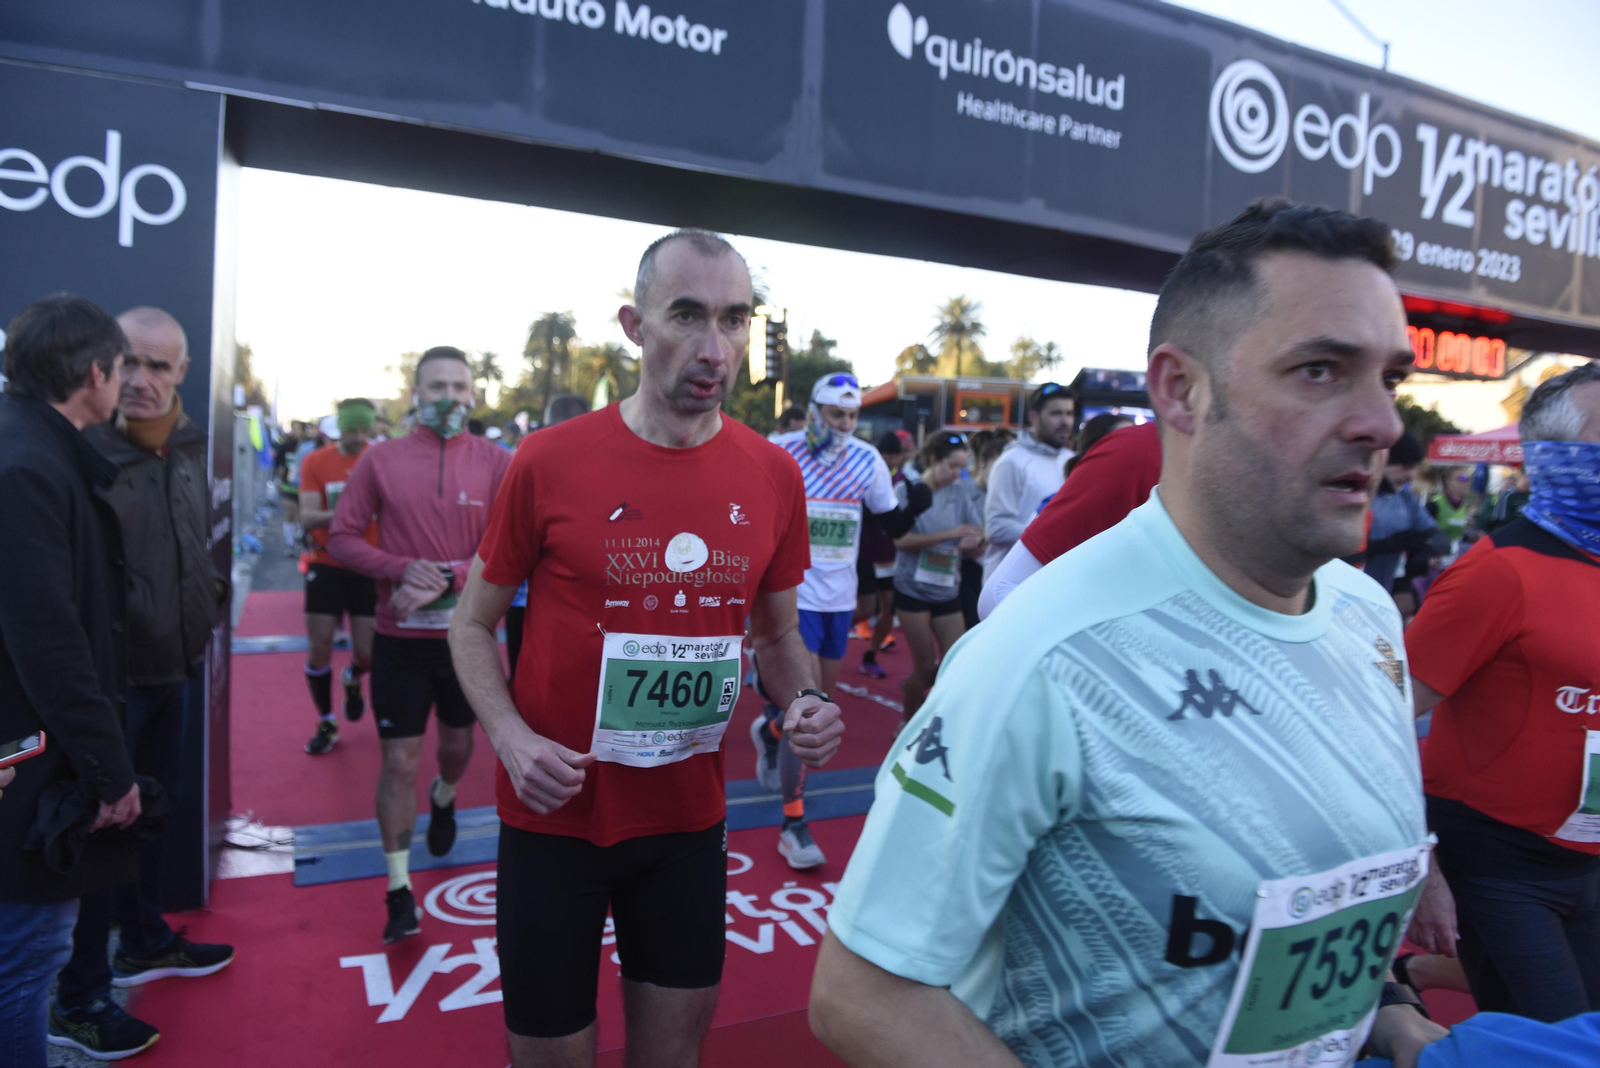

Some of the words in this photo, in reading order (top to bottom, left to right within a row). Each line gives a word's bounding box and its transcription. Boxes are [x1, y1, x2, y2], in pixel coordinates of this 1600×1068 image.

[614, 0, 728, 55] Motor
[924, 34, 1126, 111] quirónsalud
[956, 90, 1057, 136] Healthcare
[1058, 113, 1123, 150] Partner
[1293, 92, 1402, 194] edp
[0, 129, 187, 247] edp
[1503, 198, 1600, 260] sevill
[1416, 241, 1475, 273] enero
[1476, 247, 1522, 283] 2023
[605, 537, 660, 548] 11.11.2014
[809, 520, 846, 539] 6073
[605, 567, 746, 588] Niepodległości
[606, 552, 658, 569] XXVI
[712, 550, 750, 571] Bieg
[641, 642, 667, 658] edp
[685, 642, 724, 652] maratón
[694, 650, 724, 660] sevilla
[626, 669, 712, 708] 7460
[1555, 685, 1600, 715] Tr
[635, 720, 666, 728] Mariusz
[1165, 893, 1250, 969] b
[1279, 912, 1399, 1010] 7539
